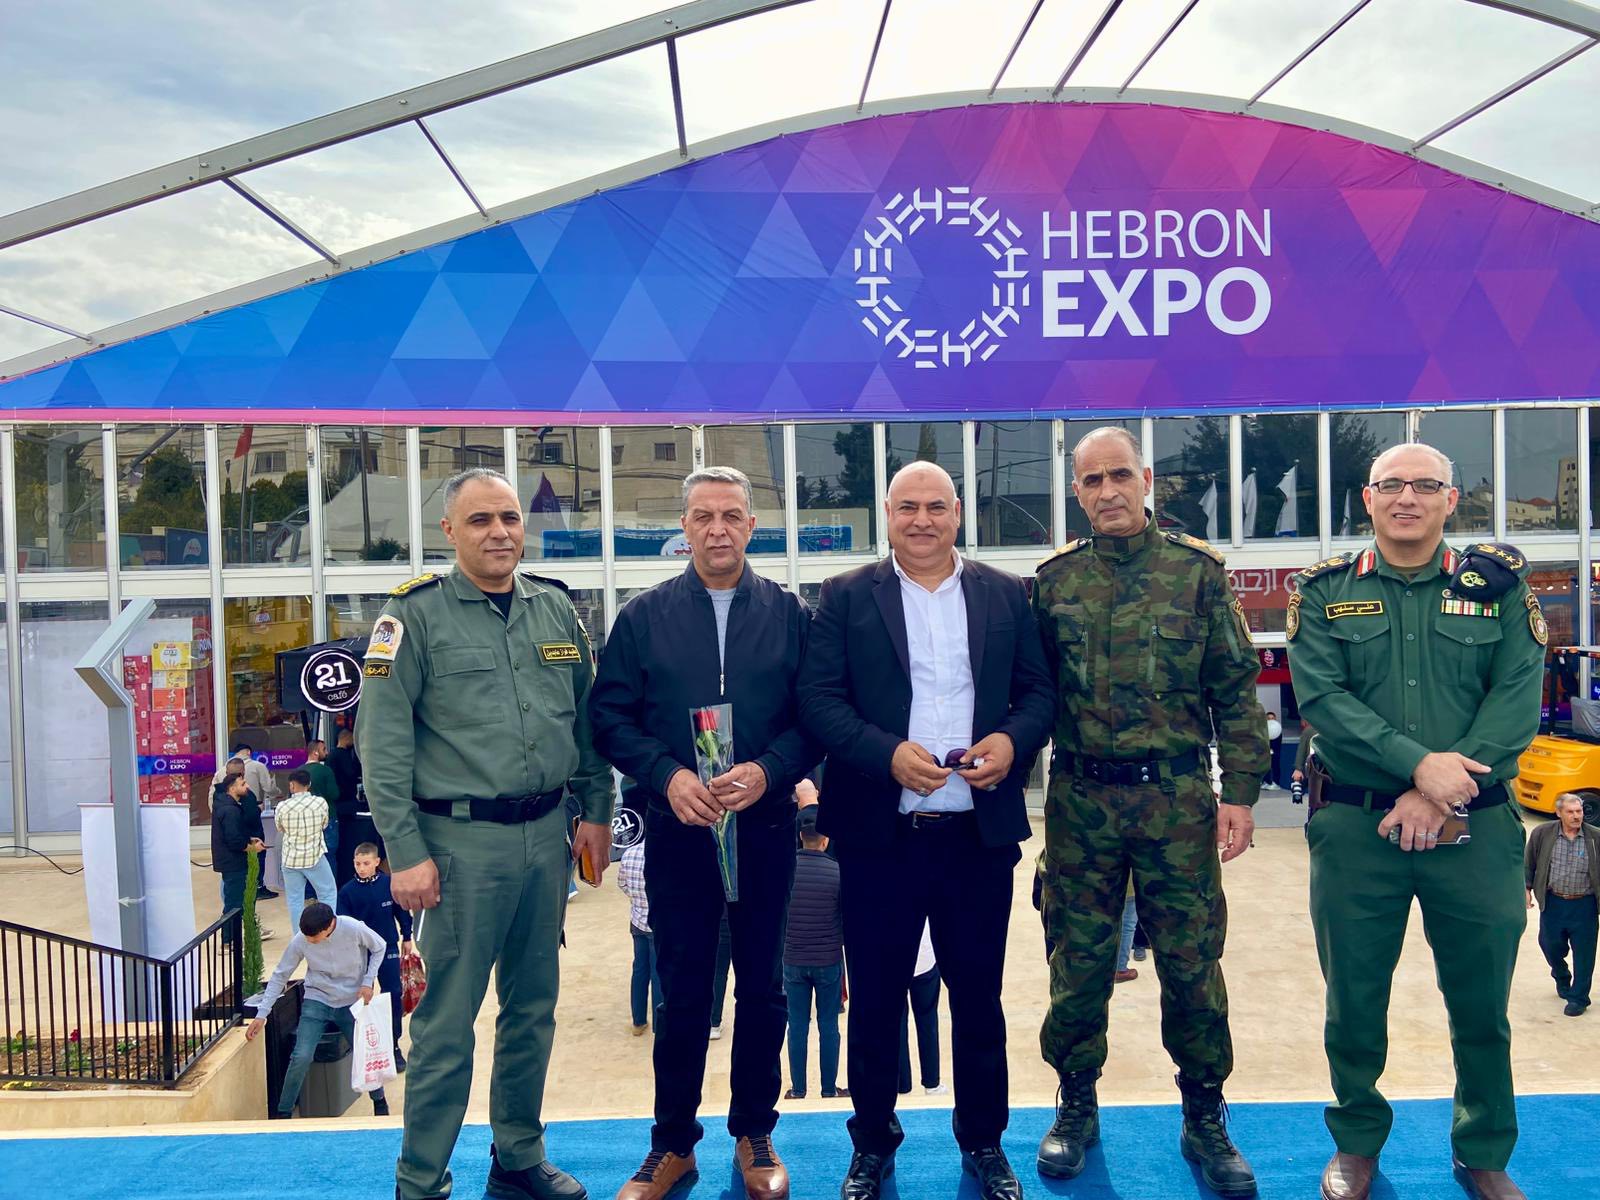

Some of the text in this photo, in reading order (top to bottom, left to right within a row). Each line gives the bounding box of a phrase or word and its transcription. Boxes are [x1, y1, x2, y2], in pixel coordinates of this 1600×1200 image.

[1042, 208, 1272, 259] HEBRON
[1042, 267, 1272, 337] EXPO
[314, 661, 352, 690] 21
[327, 690, 348, 702] café
[611, 813, 635, 835] 21
